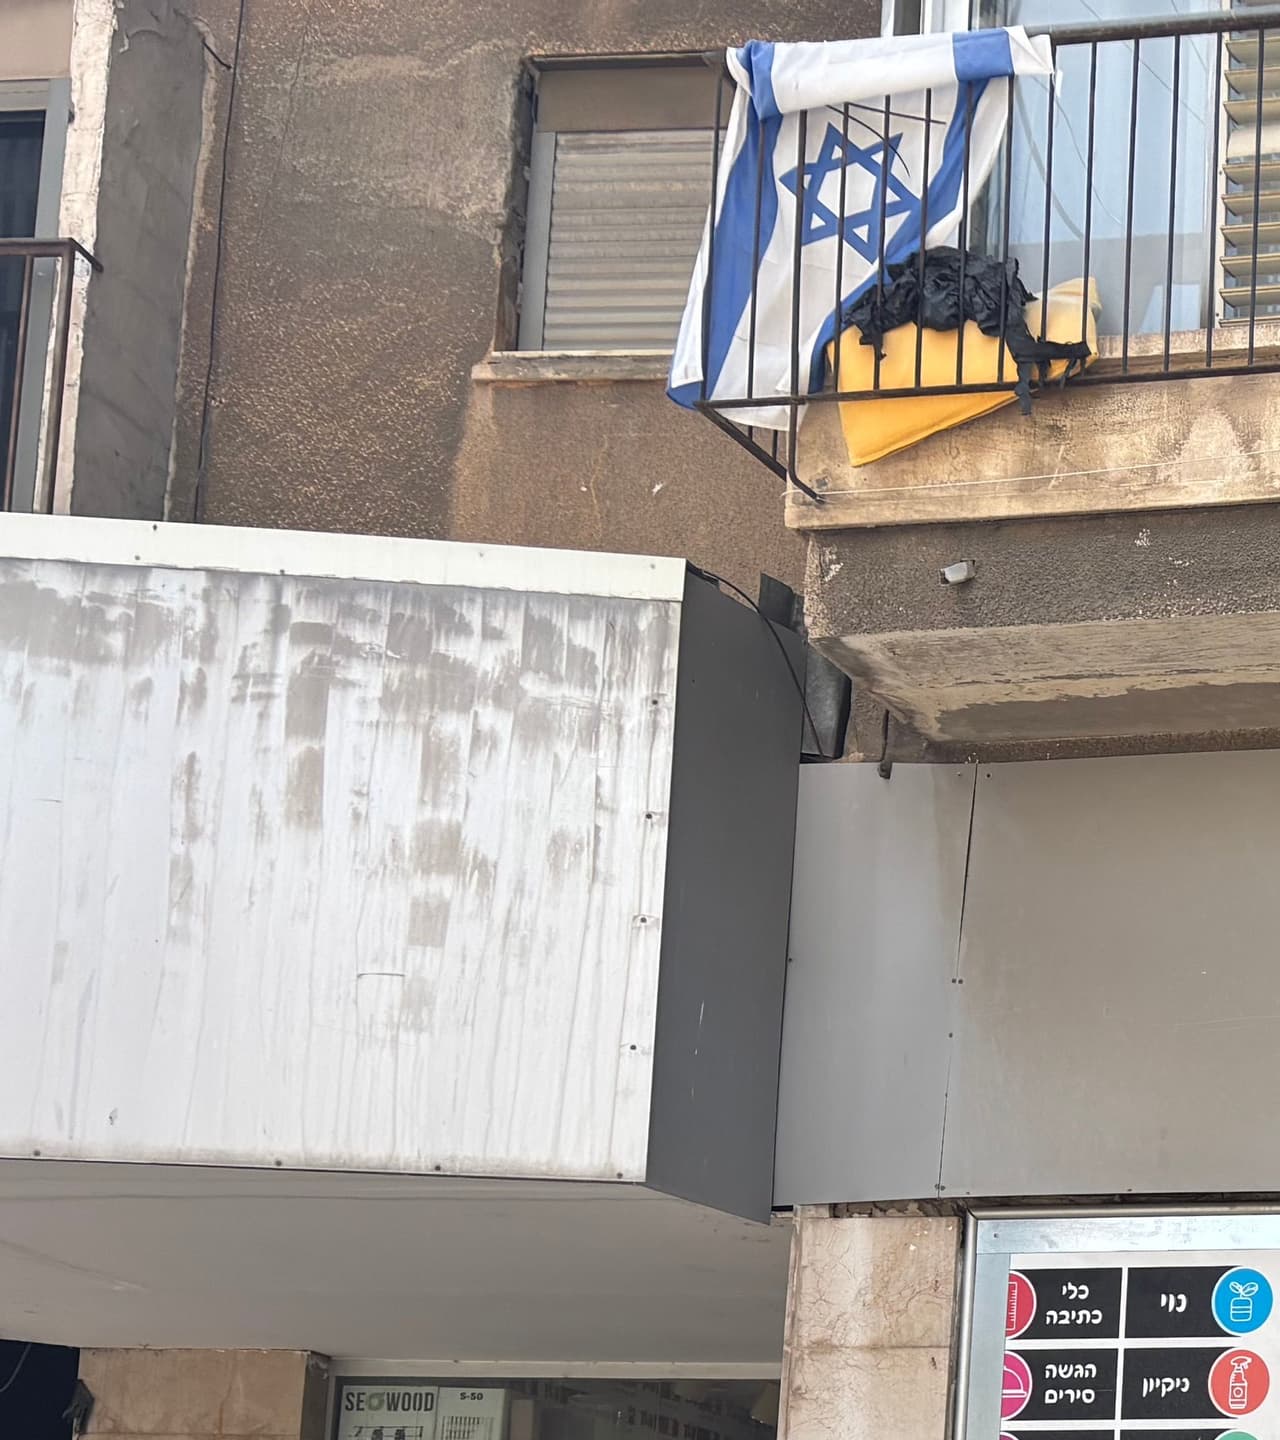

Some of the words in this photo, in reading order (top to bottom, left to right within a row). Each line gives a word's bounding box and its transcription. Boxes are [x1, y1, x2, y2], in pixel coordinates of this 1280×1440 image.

[1061, 1281, 1090, 1300] כלי
[1160, 1292, 1187, 1312] נוי
[1045, 1308, 1102, 1327] כתיבה
[1044, 1361, 1097, 1380] הגשה
[1141, 1373, 1191, 1397] ניקיון
[460, 1392, 484, 1401] S-50
[1045, 1387, 1095, 1405] סירים
